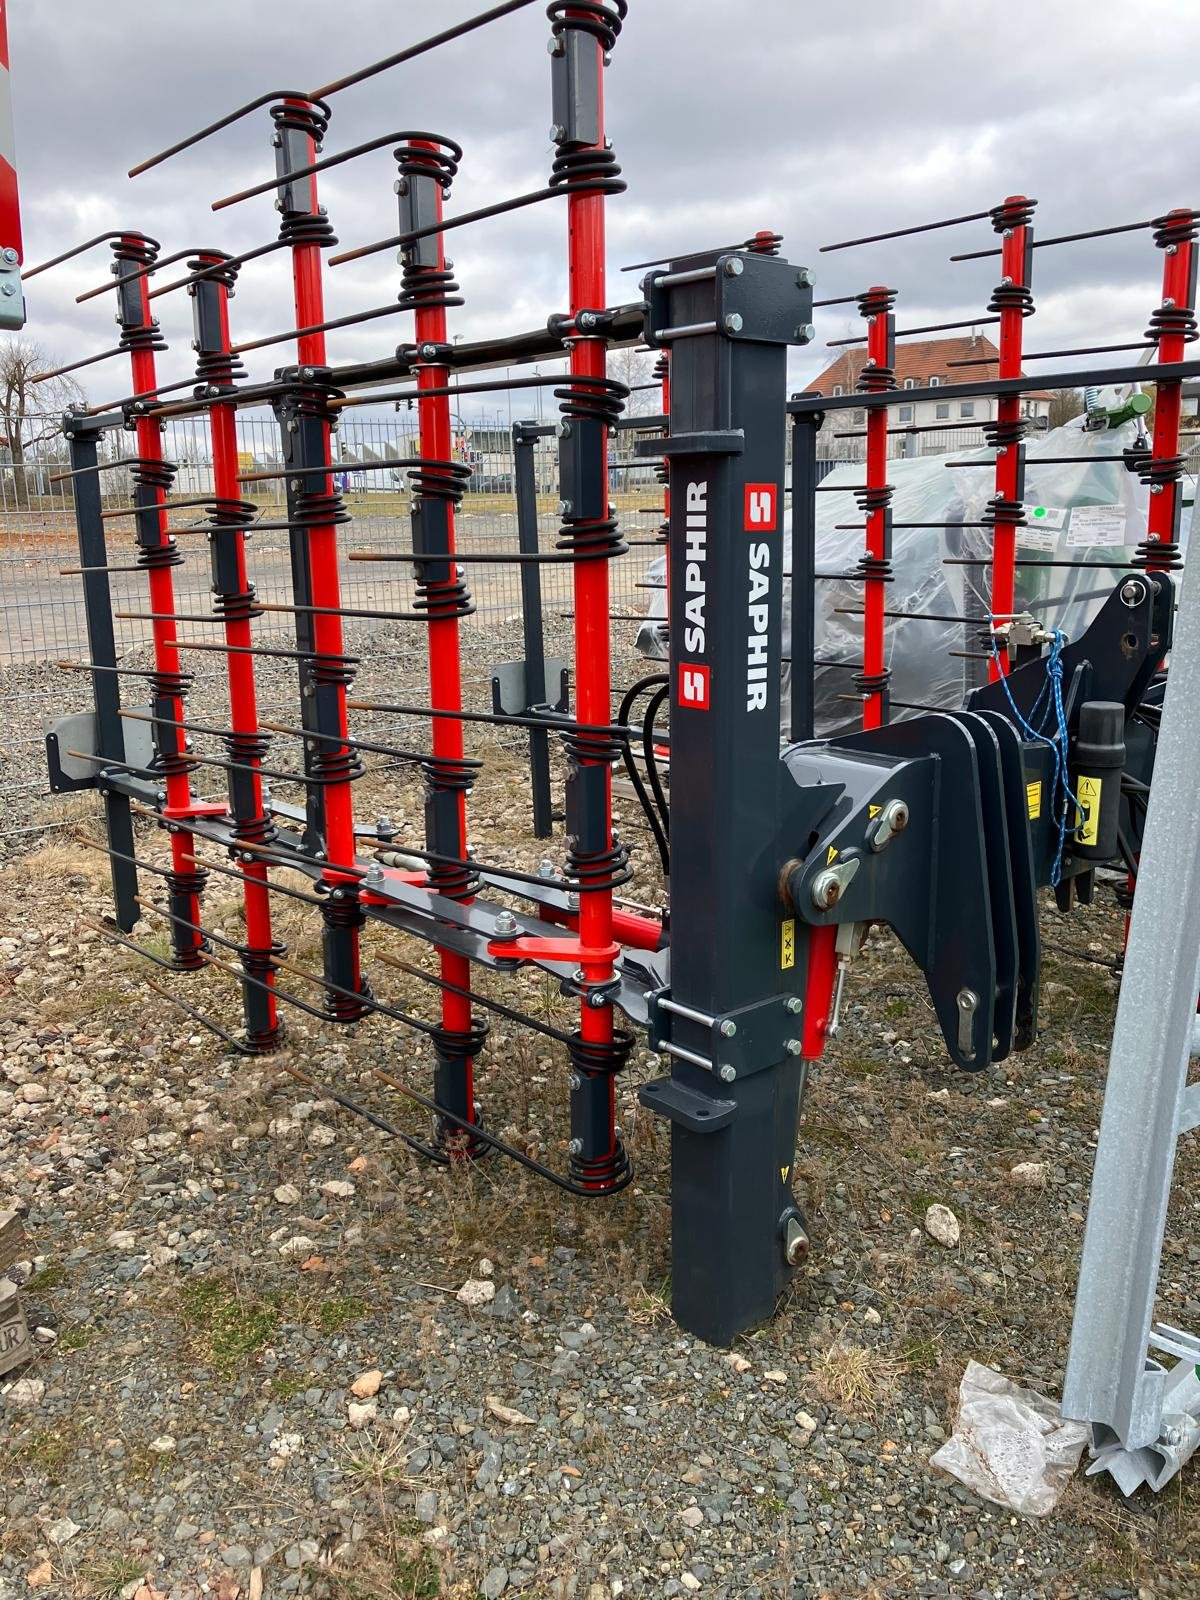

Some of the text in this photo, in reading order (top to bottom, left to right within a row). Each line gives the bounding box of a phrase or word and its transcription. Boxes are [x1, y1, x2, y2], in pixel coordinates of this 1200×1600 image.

[685, 480, 708, 654] SAPHIR
[747, 542, 770, 713] SAPHIR
[0, 1327, 20, 1352] UR
